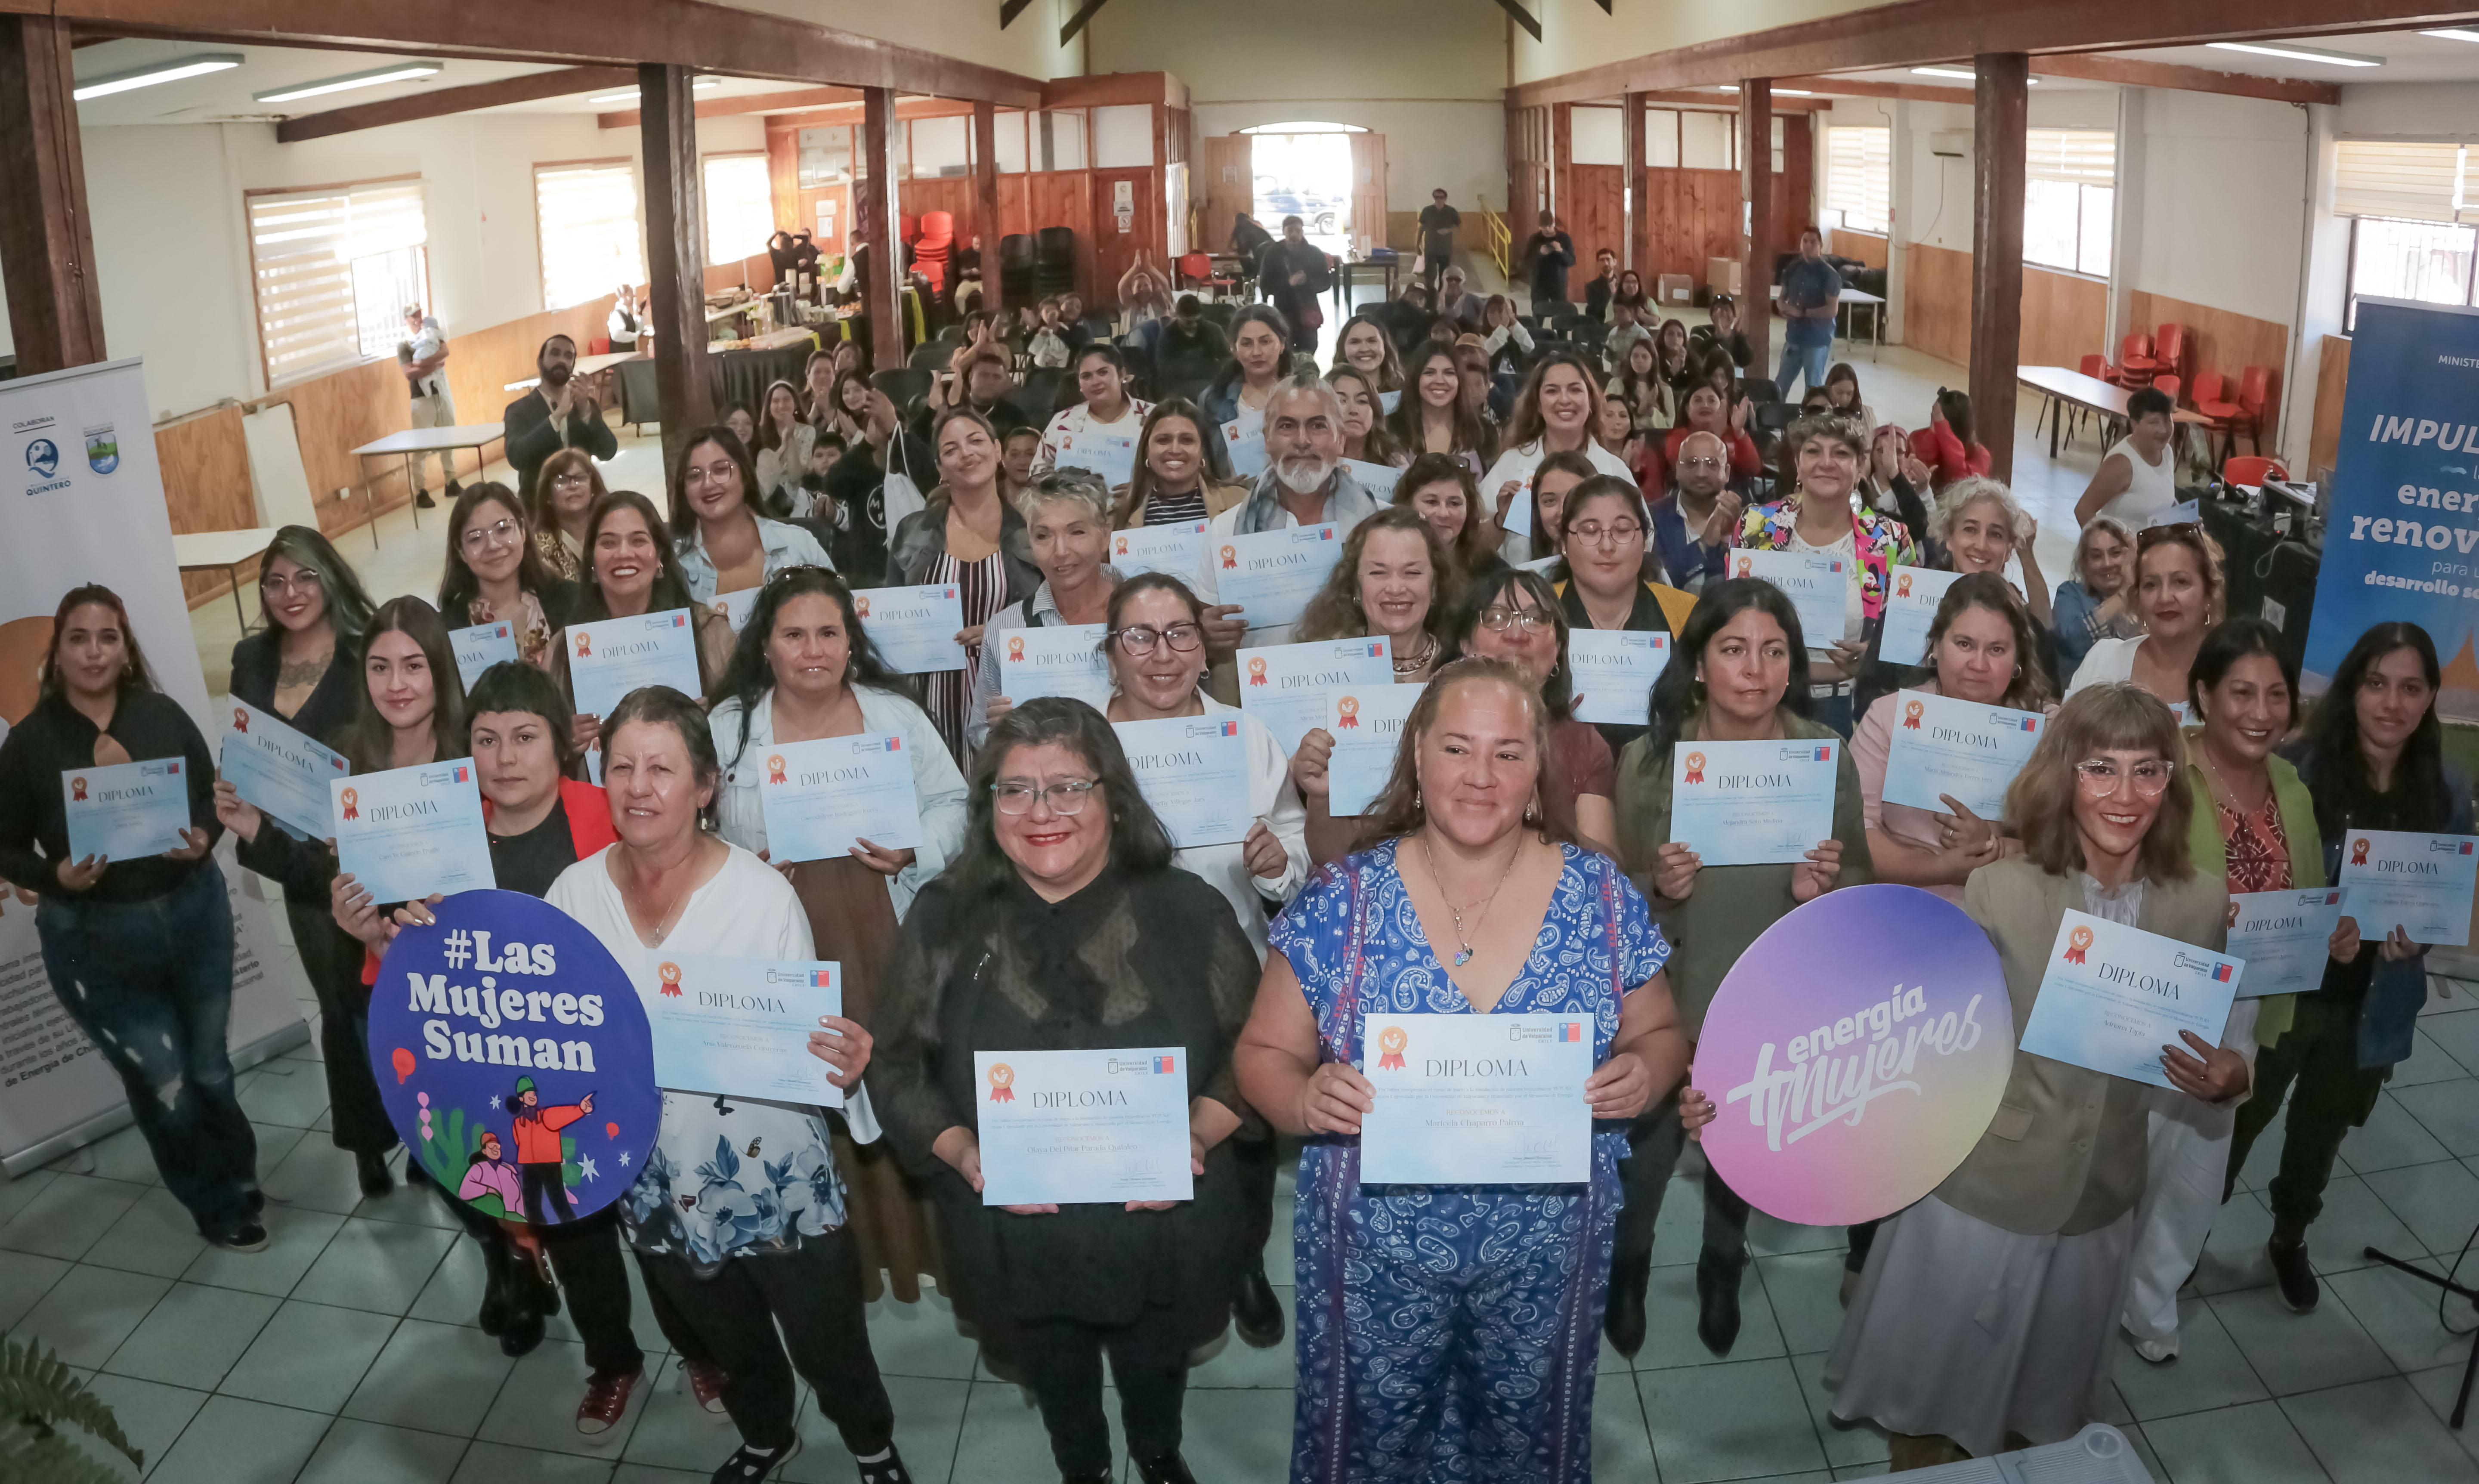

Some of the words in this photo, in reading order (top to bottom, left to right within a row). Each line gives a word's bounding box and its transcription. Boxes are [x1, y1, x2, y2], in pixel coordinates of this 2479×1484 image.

[12, 416, 55, 429] COLABORAN
[2369, 414, 2479, 454] IMPUL
[2398, 484, 2479, 514] ener
[2349, 515, 2479, 553] renov
[1137, 543, 1184, 556] DIPLOMA
[1248, 553, 1307, 571] DIPLOMA
[2432, 561, 2468, 575] para
[2365, 570, 2459, 596] desarrollo
[880, 608, 930, 621] DIPLOMA
[603, 640, 659, 659] DIPLOMA
[1036, 652, 1097, 665] DIPLOMA
[1572, 653, 1632, 665] DIPLOMA
[1281, 671, 1350, 689] DIPLOMA
[1932, 726, 1997, 749] DIPLOMA
[258, 736, 314, 773] DIPLOMA
[1127, 751, 1202, 771] DIPLOMA
[801, 766, 869, 786] DIPLOMA
[1718, 774, 1791, 789] DIPLOMA
[99, 786, 154, 803] DIPLOMA
[371, 800, 438, 822] DIPLOMA
[2377, 860, 2438, 875] DIPLOMA
[2244, 916, 2303, 933] DIPLOMA
[444, 928, 556, 977] #Las
[2098, 962, 2179, 1000] DIPLOMA
[406, 972, 604, 1029] Mujeres
[699, 991, 785, 1013] DIPLOMA
[1787, 983, 1927, 1064] energía
[2103, 1020, 2127, 1032] Adriana
[422, 1019, 596, 1073] Suman
[1425, 1059, 1528, 1077] DIPLOMA
[1032, 1089, 1128, 1108] DIPLOMA
[1460, 1119, 1497, 1128] Chaparro
